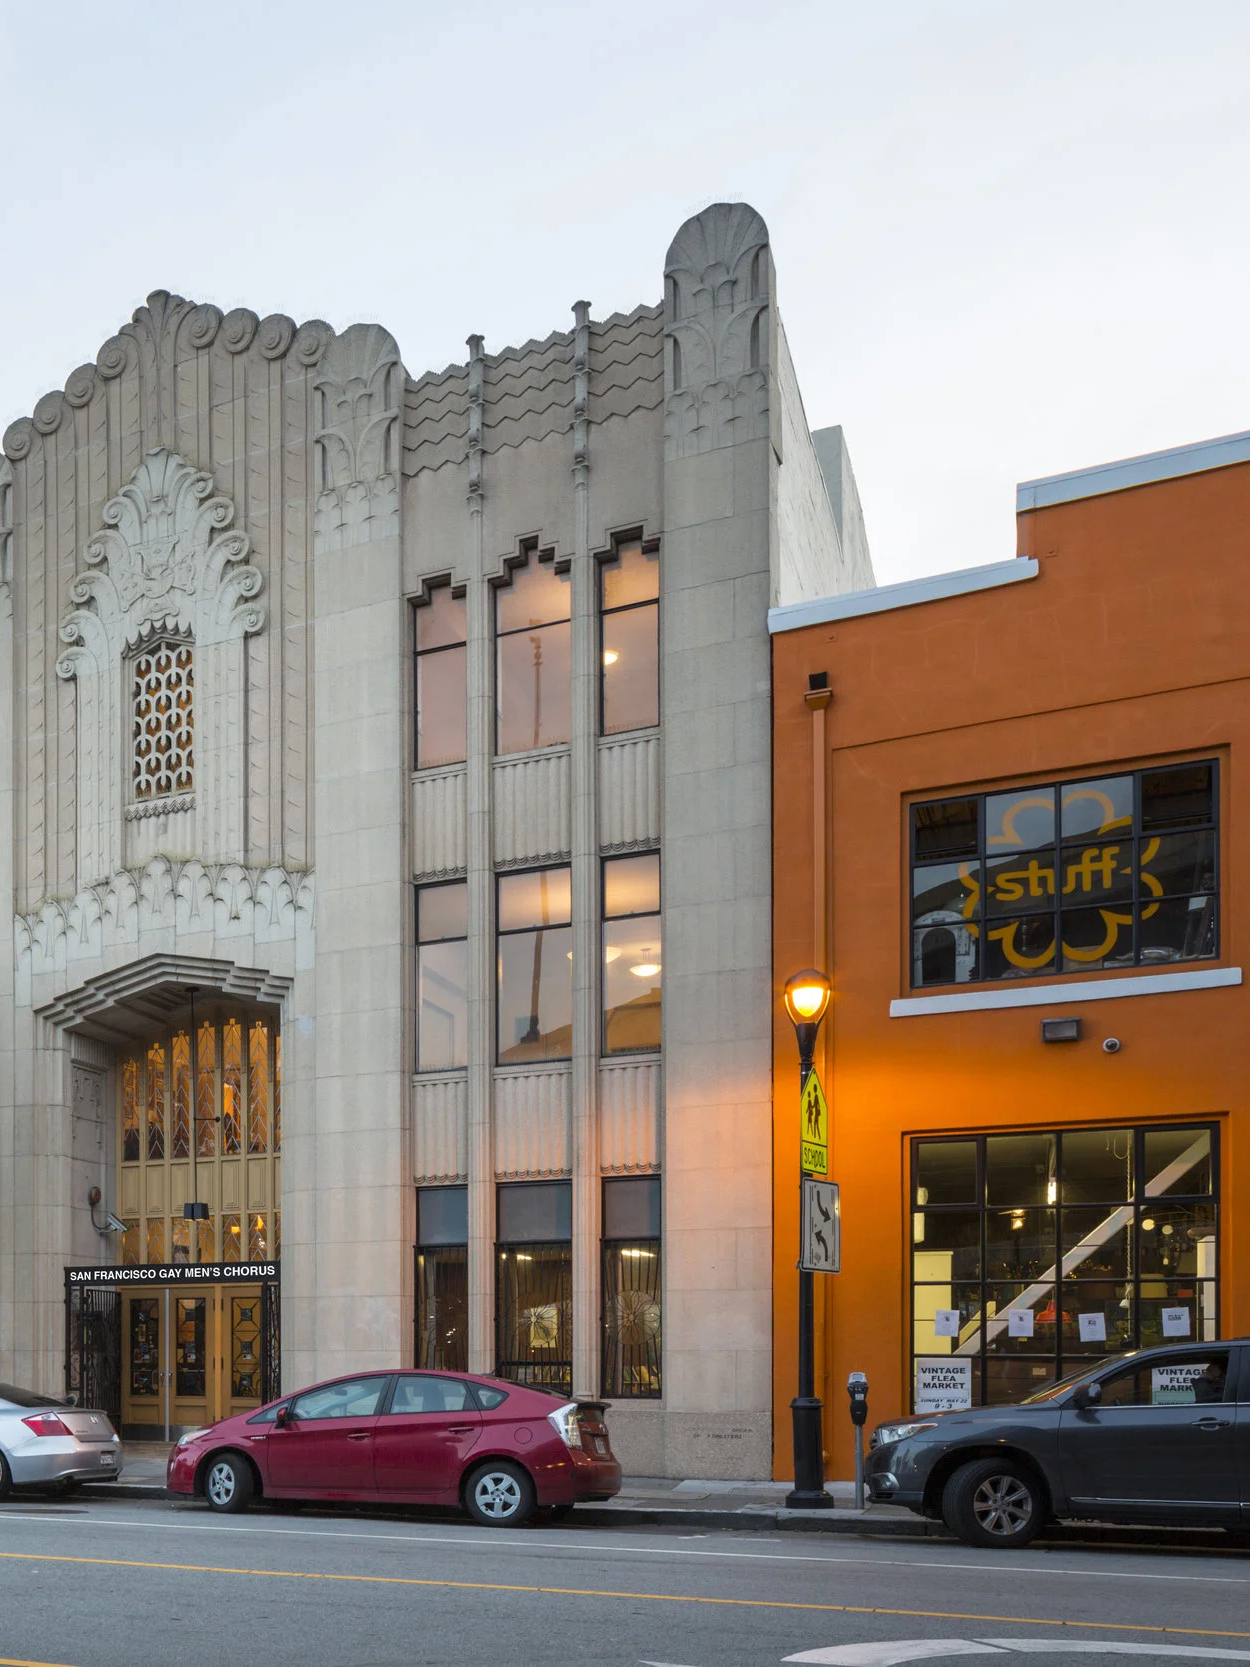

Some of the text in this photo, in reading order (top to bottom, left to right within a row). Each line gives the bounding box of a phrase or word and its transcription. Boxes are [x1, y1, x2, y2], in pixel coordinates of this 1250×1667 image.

[995, 846, 1120, 901] stuff
[804, 1147, 826, 1169] SCHOOL
[70, 1265, 275, 1281] SAN FRANCISCO GAY MEN'S CHORUS
